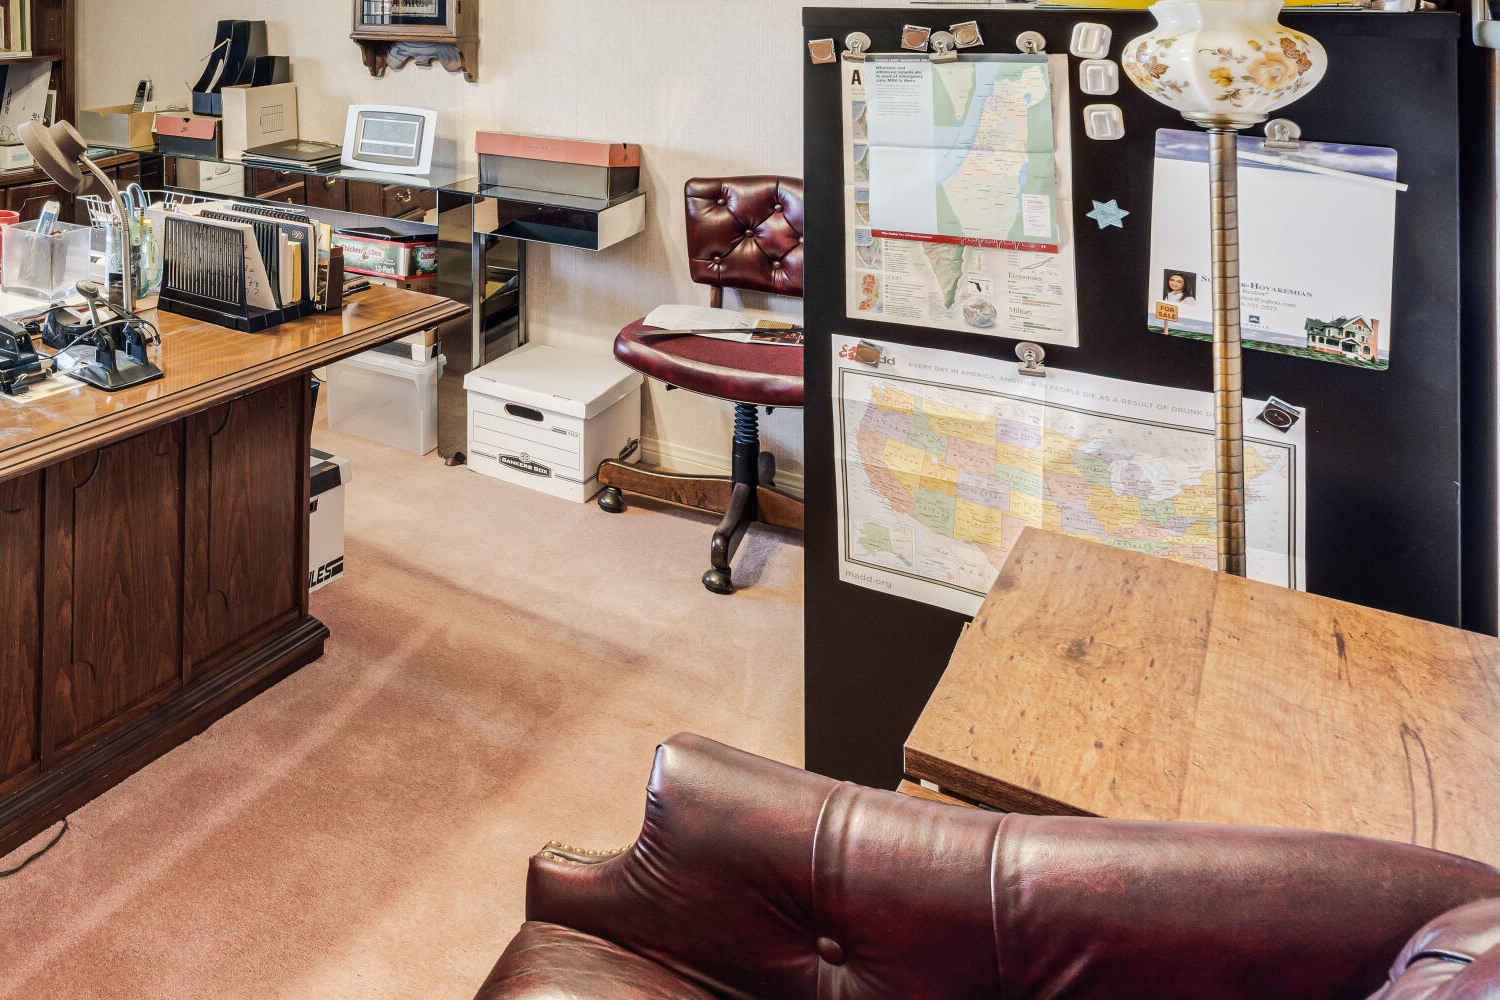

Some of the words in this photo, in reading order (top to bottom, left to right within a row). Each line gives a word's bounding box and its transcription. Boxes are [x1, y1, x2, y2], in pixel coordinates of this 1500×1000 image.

[851, 69, 862, 85] A
[341, 243, 363, 254] Chicken
[371, 248, 382, 257] Sea
[374, 264, 396, 275] 12-Pack
[1008, 306, 1034, 317] Military
[1158, 311, 1177, 320] SALE
[879, 355, 896, 366] dd
[908, 362, 932, 370] EVERY
[960, 371, 997, 382] AMERICA,
[1048, 384, 1081, 397] PEOPLE
[1082, 391, 1097, 399] DIE
[1099, 394, 1111, 402] AS
[1121, 398, 1155, 409] RESULT
[1171, 406, 1203, 417] DRUNK
[500, 456, 533, 472] BANKERS
[533, 465, 549, 476] BOX
[845, 568, 893, 589] madd.org
